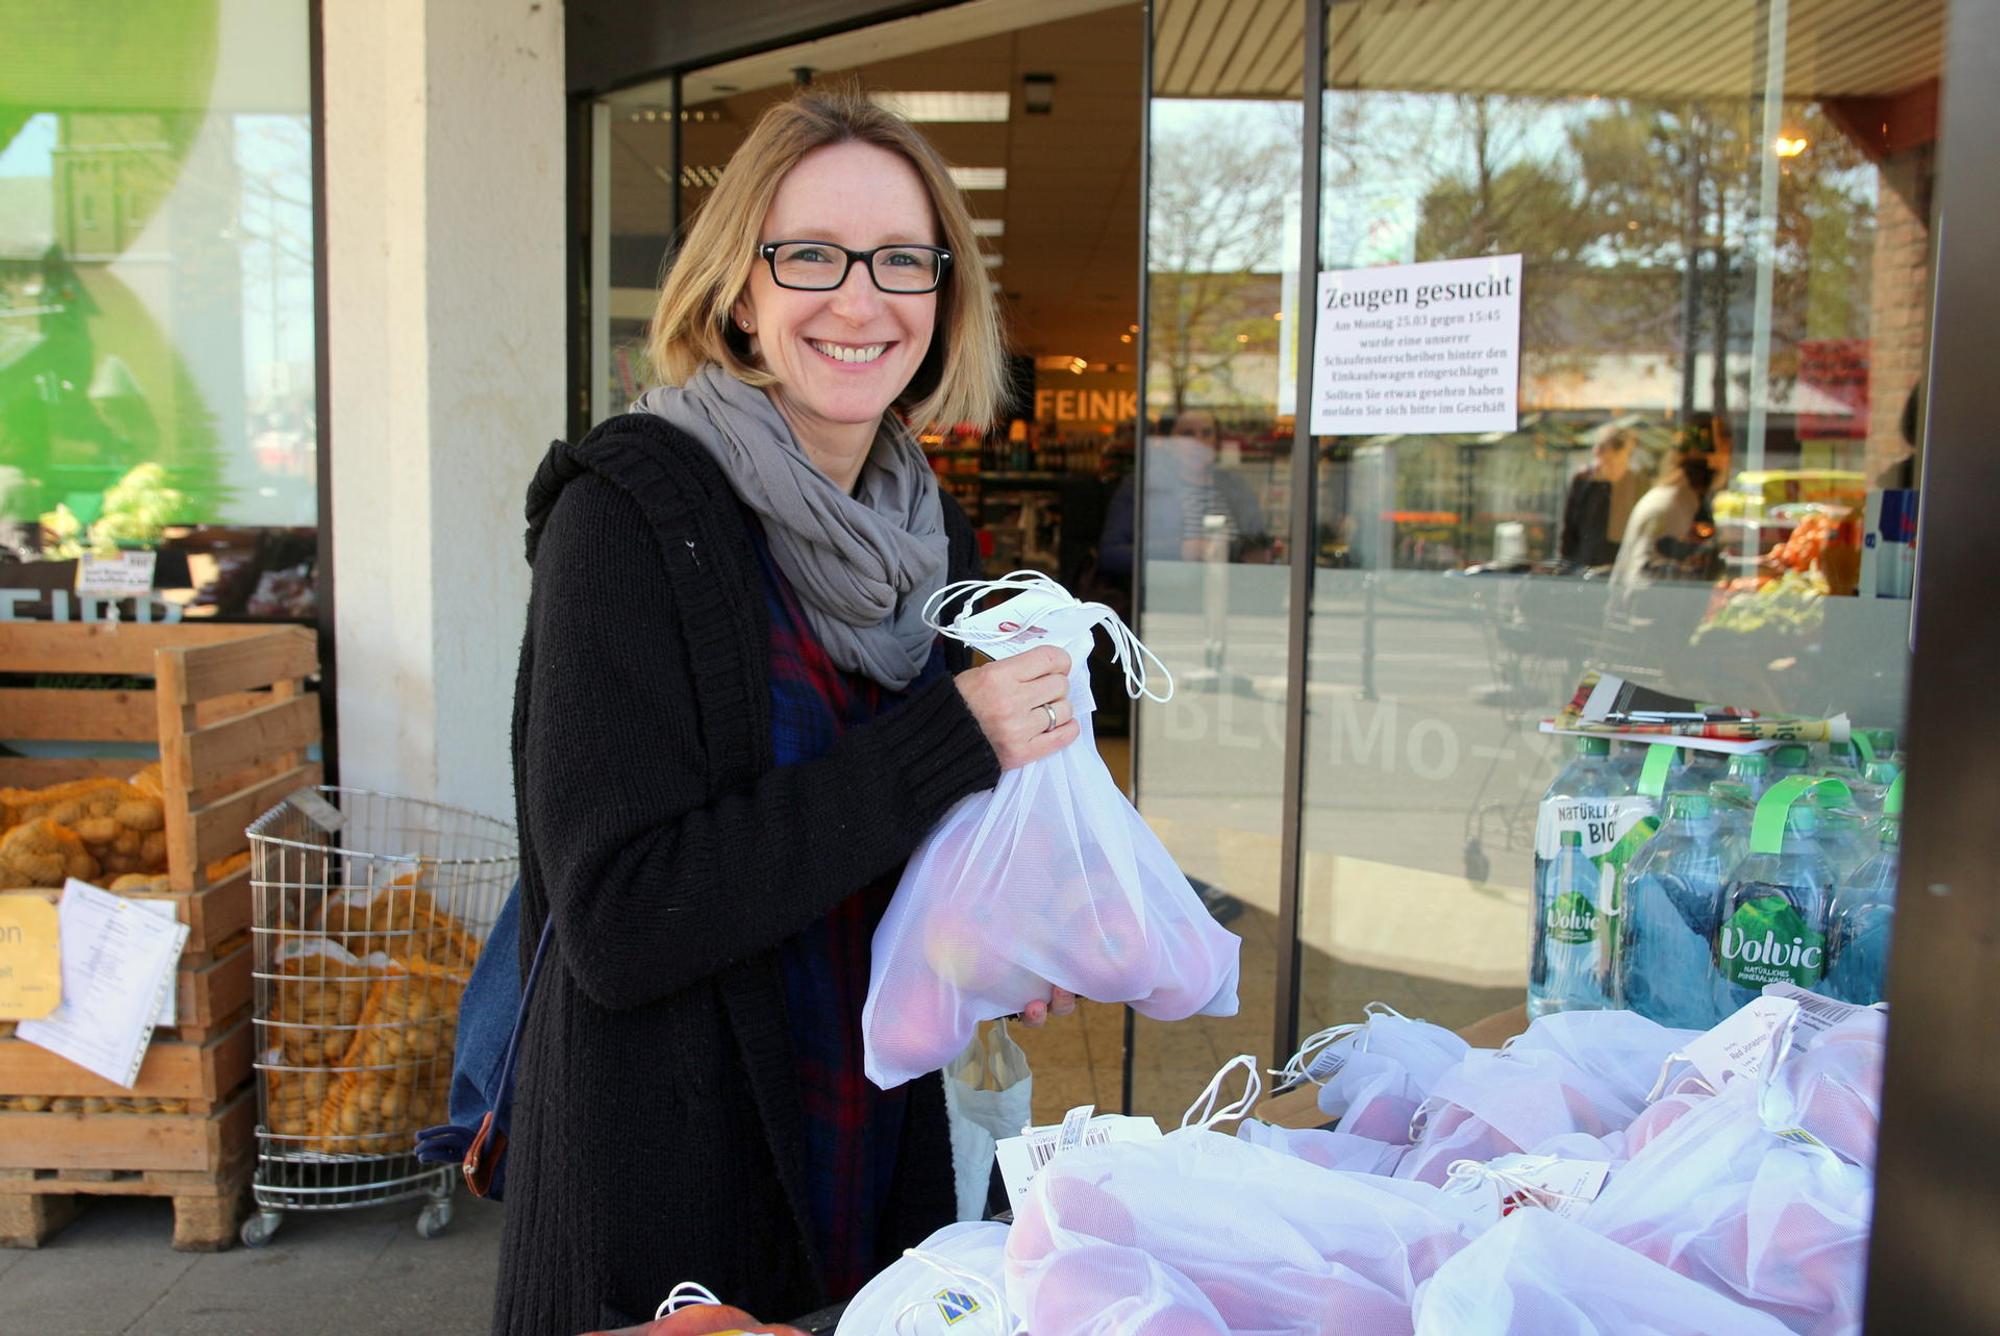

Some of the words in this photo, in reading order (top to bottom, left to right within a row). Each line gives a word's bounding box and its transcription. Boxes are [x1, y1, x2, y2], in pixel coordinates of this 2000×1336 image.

[1325, 287, 1409, 312] Zeugen
[1415, 274, 1513, 309] gesucht
[1333, 320, 1351, 331] Am
[1354, 318, 1393, 330] Montag
[1430, 313, 1465, 327] gegen
[1359, 337, 1394, 348] wurde
[1397, 336, 1421, 347] eine
[1424, 333, 1470, 346] unserer
[1324, 350, 1445, 366] Schaufensterscheiben
[1447, 348, 1483, 360] hinter
[1486, 347, 1508, 359] den
[1331, 370, 1415, 382] Einkaufswagen
[1417, 364, 1498, 380] eingeschlagen
[1325, 389, 1363, 401] Sollten
[1365, 388, 1381, 400] Sie
[1384, 387, 1417, 399] etwas
[1419, 386, 1465, 400] gesehen
[1468, 384, 1504, 396] haben
[1321, 405, 1363, 417] melden
[1366, 405, 1382, 416] Sie
[1385, 404, 1407, 415] sich
[1410, 403, 1436, 415] bitte
[1439, 402, 1453, 414] im
[1456, 400, 1506, 414] Geschäft
[1548, 910, 1599, 931] Volvic
[1721, 927, 1822, 969] Volvic
